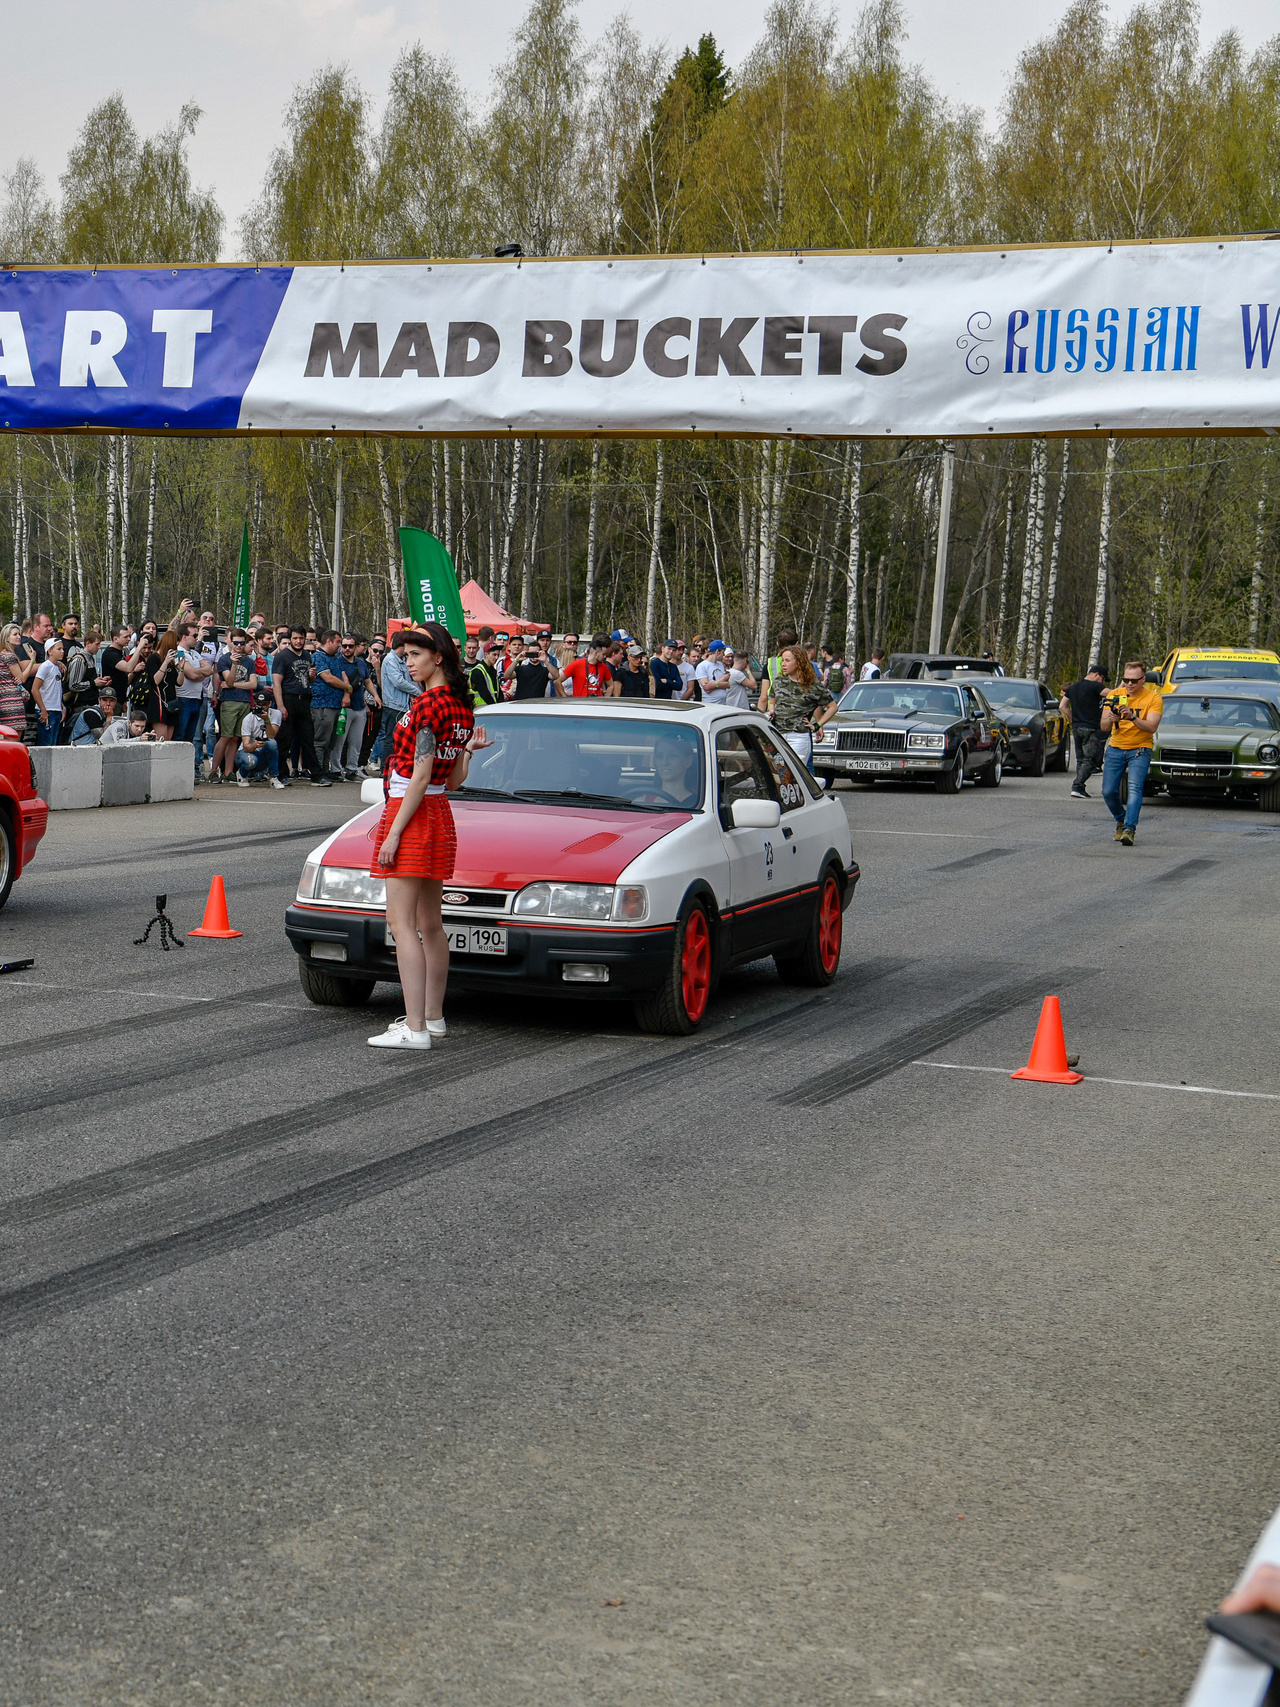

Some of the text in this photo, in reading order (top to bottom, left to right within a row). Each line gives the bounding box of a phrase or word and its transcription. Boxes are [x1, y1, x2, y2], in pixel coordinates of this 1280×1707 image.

[304, 313, 908, 378] MAD BUCKETS
[1003, 305, 1201, 374] RUSSIAN
[419, 579, 436, 622] EDOM
[452, 723, 471, 743] Hey
[764, 841, 774, 866] 23
[447, 894, 463, 902] Ford
[472, 929, 501, 946] 190
